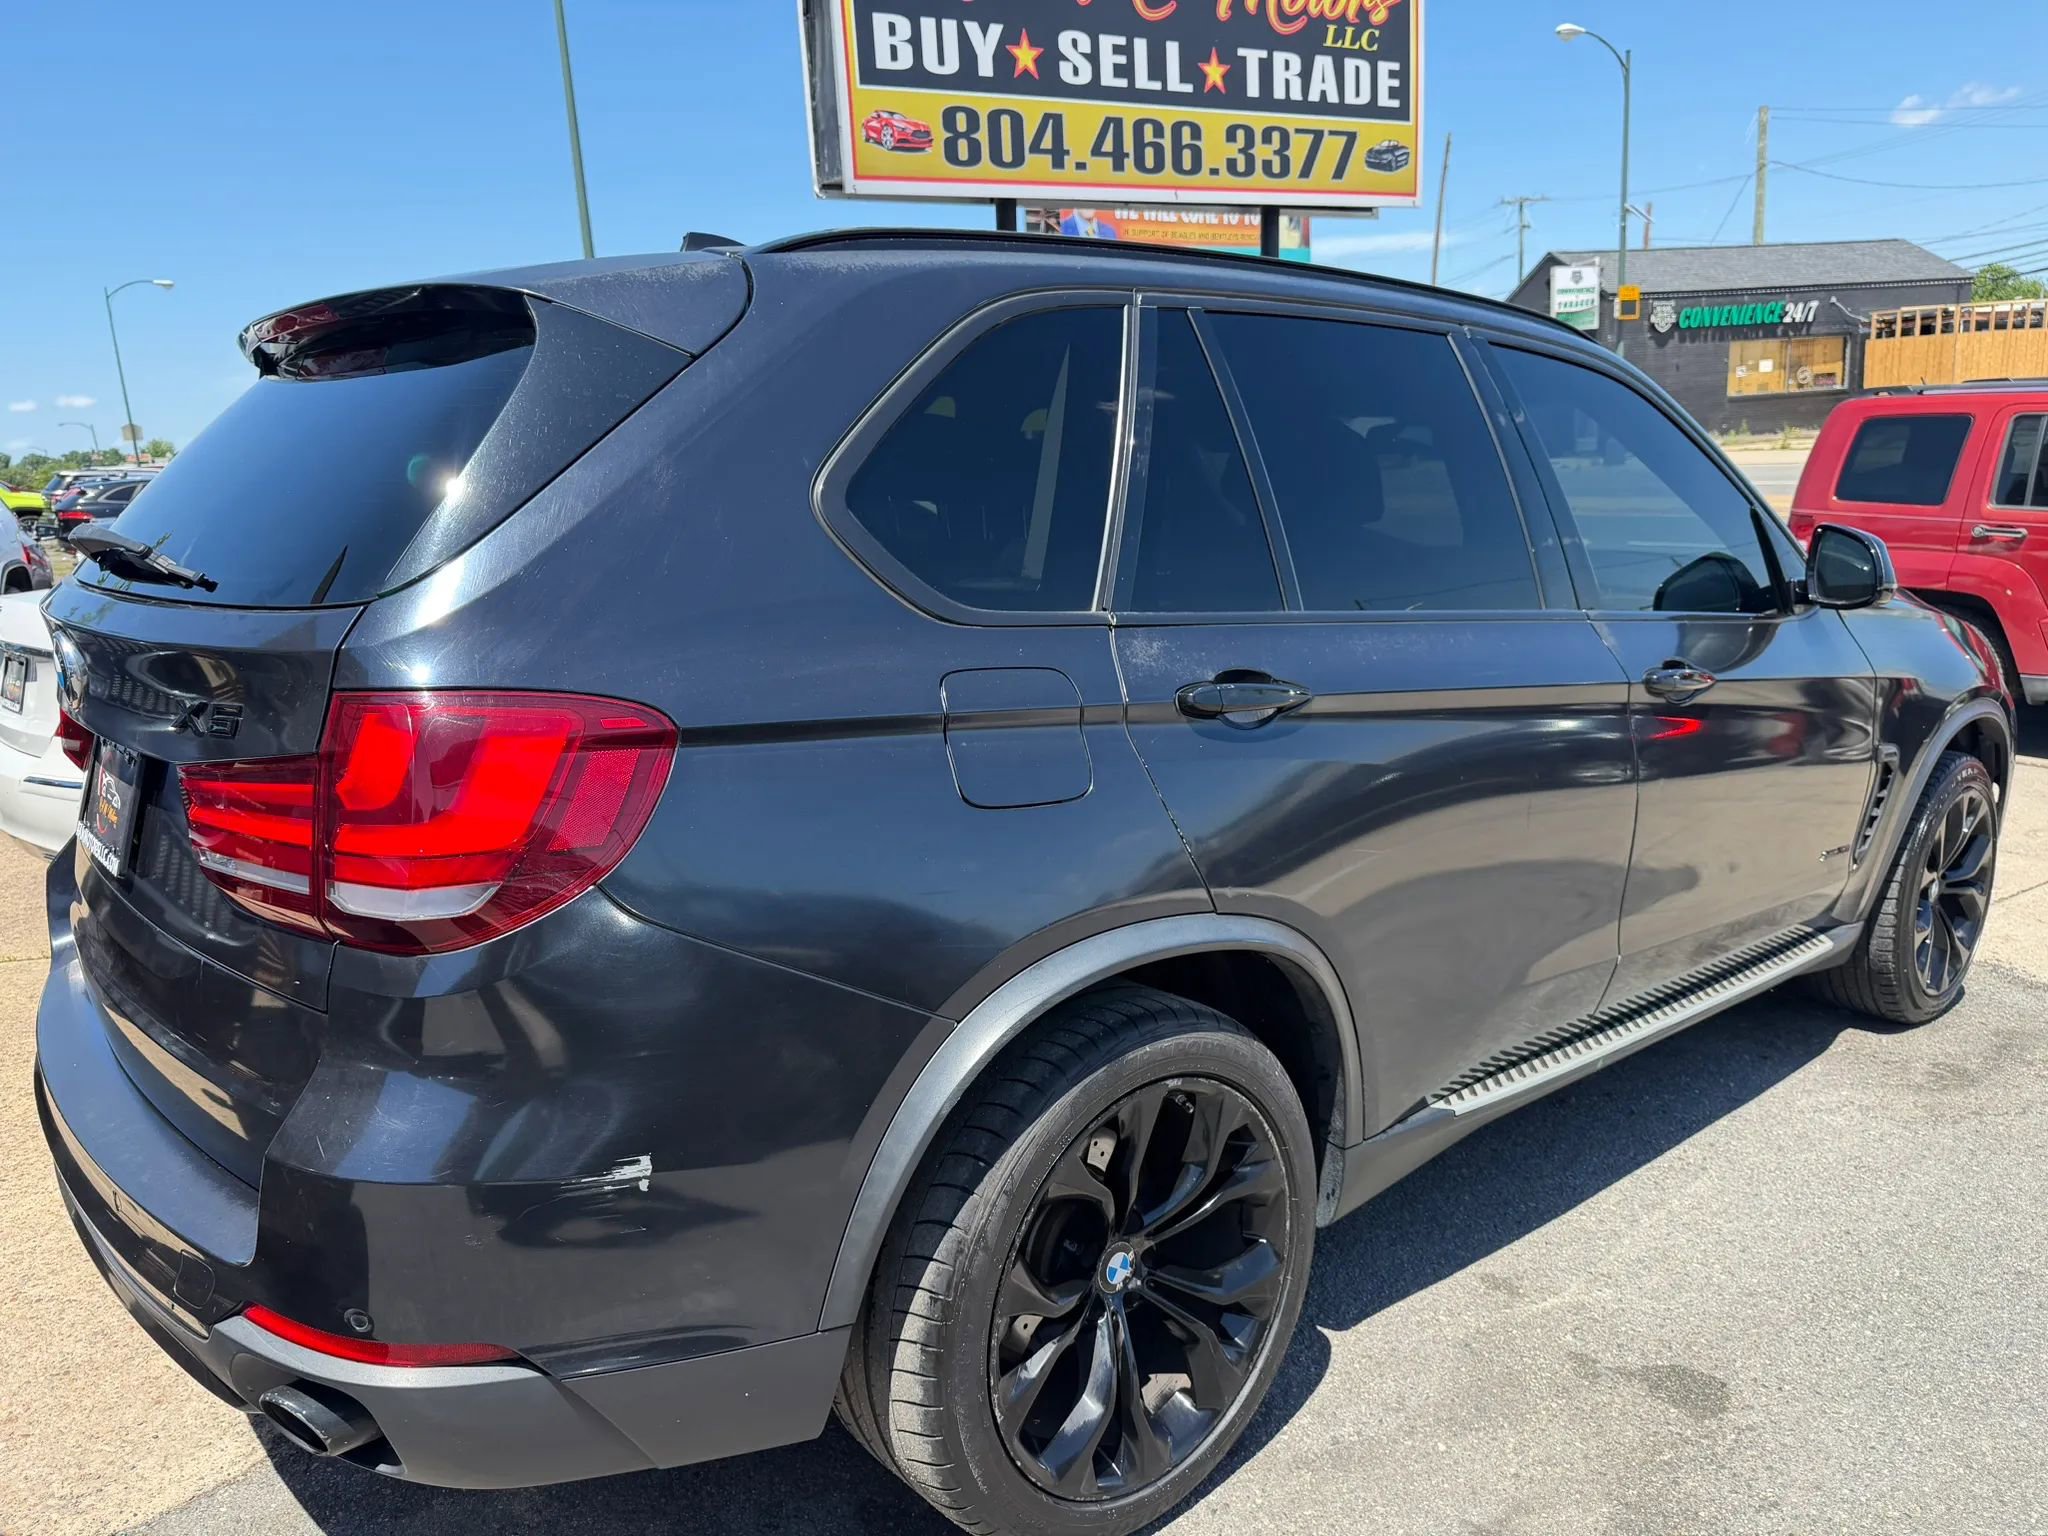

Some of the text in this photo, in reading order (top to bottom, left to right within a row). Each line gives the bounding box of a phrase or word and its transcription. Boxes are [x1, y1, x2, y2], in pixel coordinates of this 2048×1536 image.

[1322, 24, 1380, 52] LLC
[871, 13, 1402, 109] BUY SELL TRADE
[940, 104, 1360, 183] 804.466.3377
[1679, 300, 1819, 328] CONVENIENCE 24/7
[170, 698, 244, 739] X5
